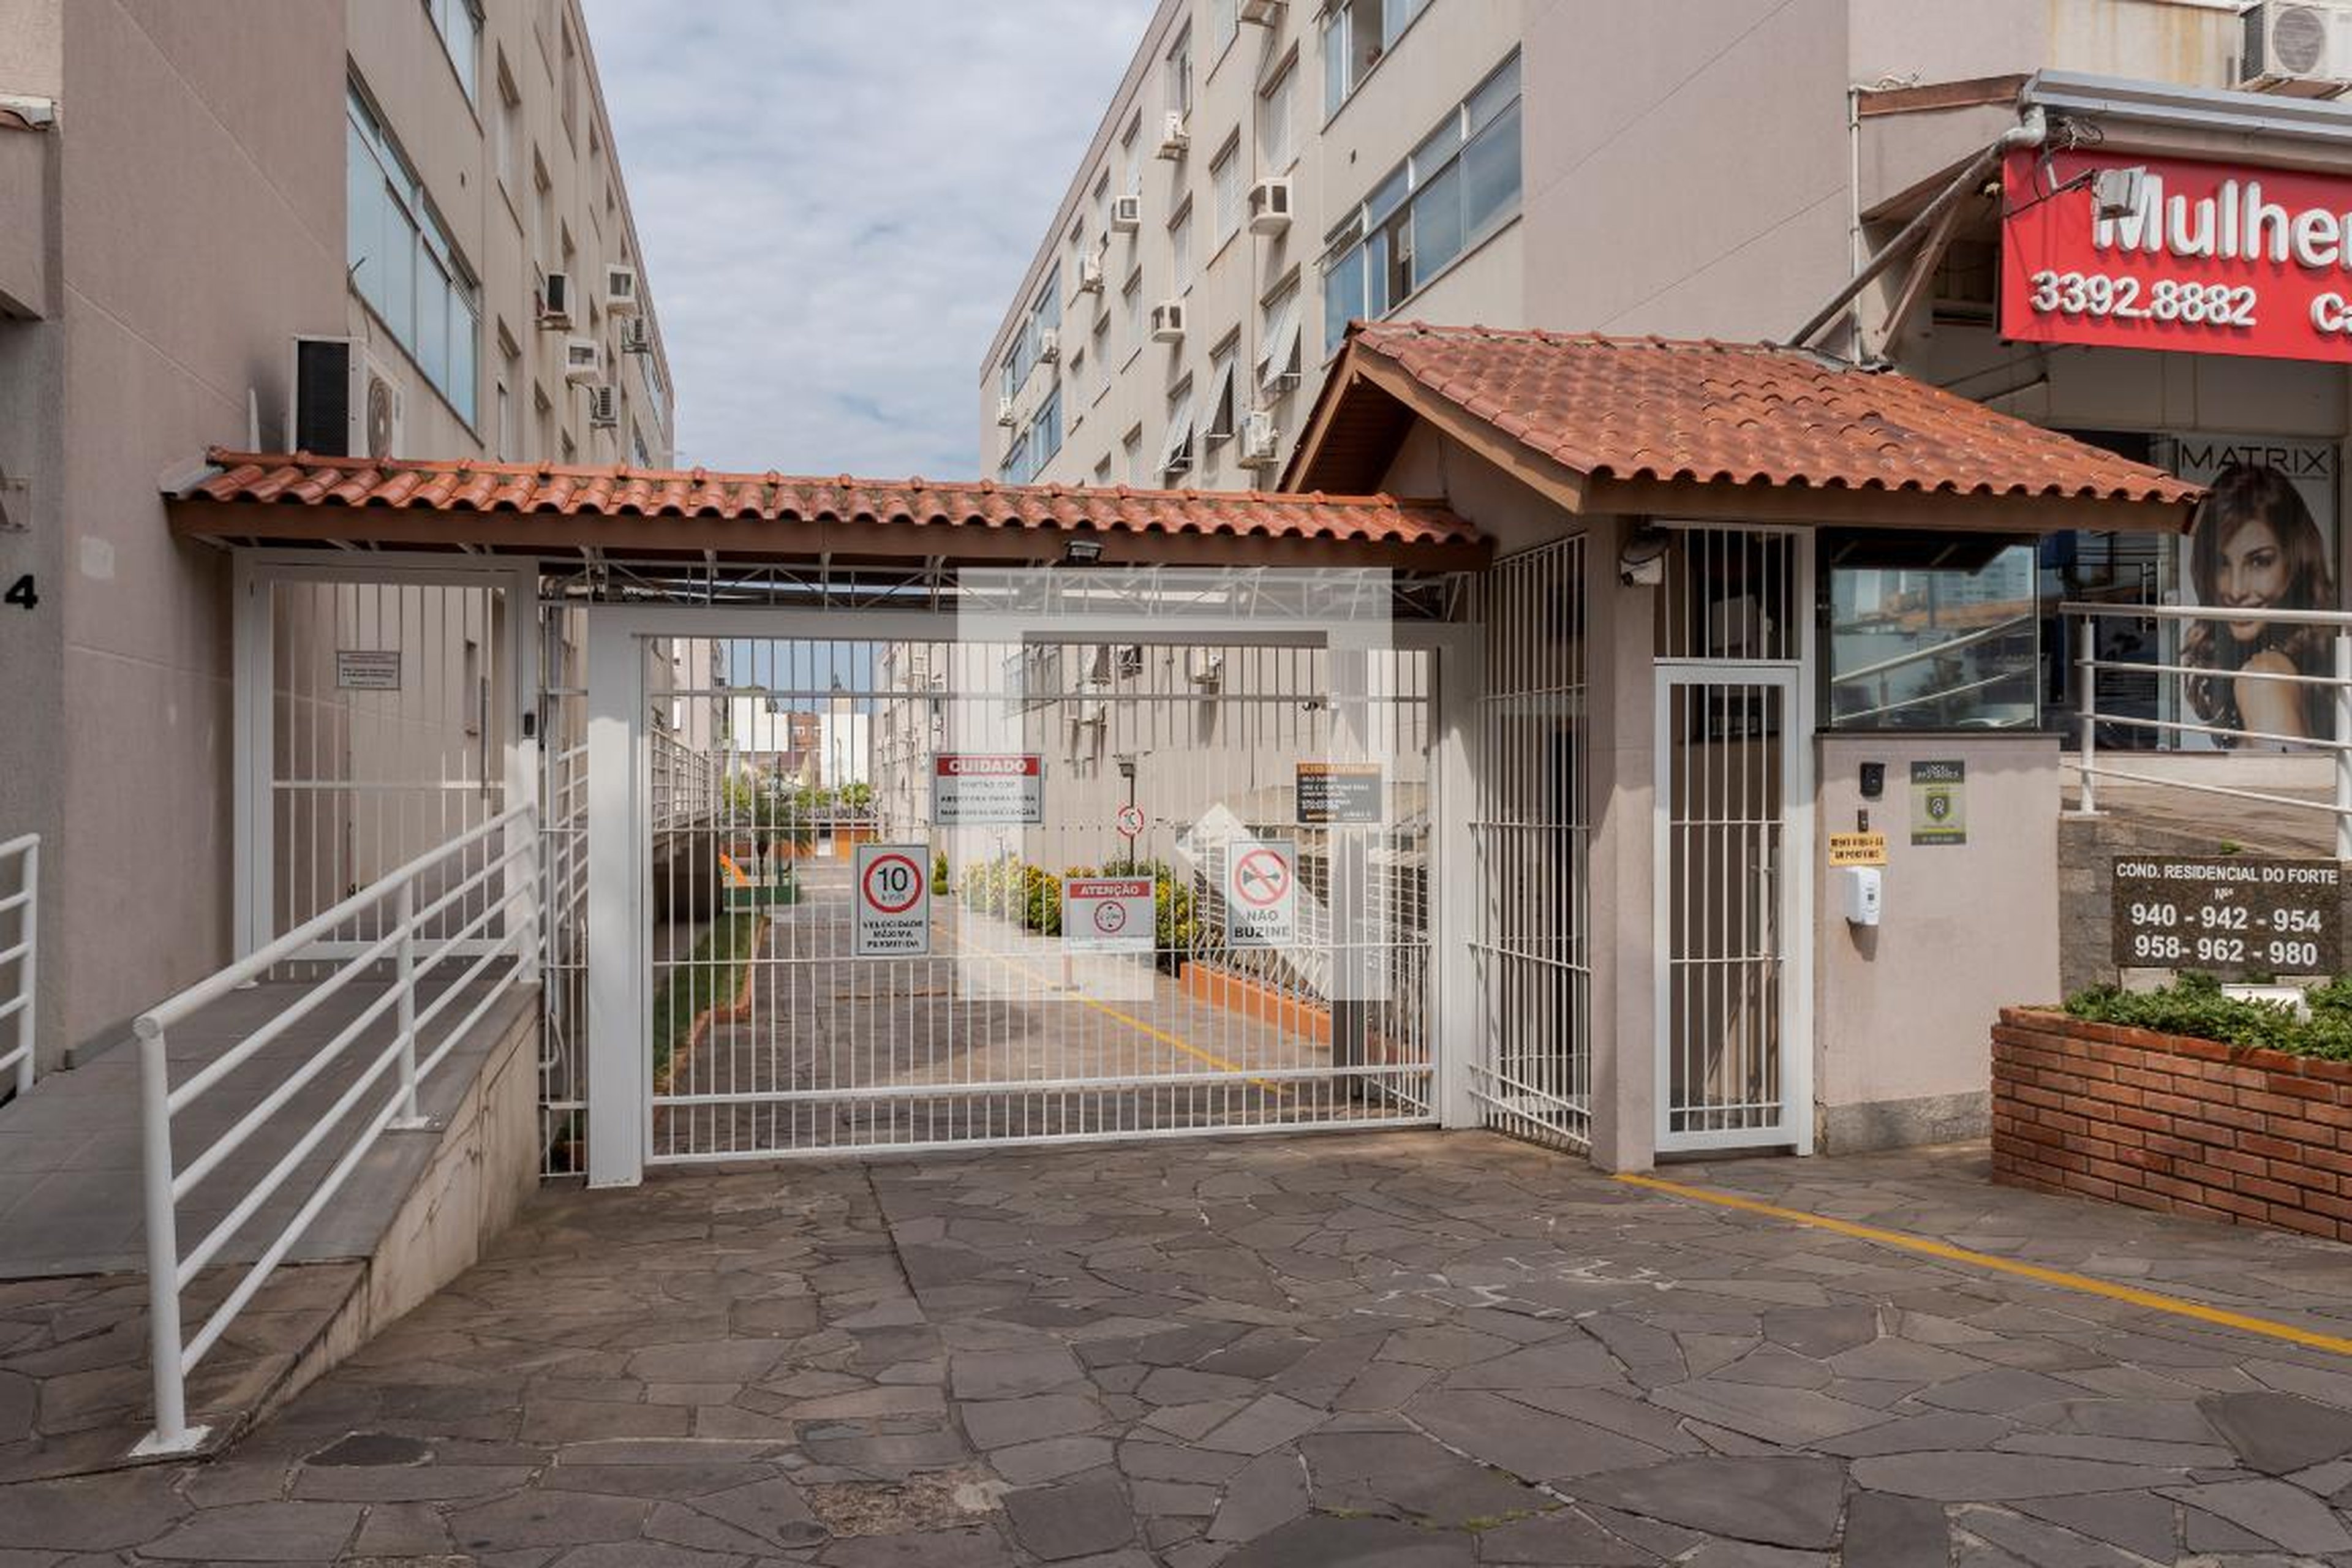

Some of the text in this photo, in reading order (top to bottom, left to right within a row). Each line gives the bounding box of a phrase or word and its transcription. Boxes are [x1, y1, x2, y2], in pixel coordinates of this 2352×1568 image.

[2030, 270, 2258, 327] 3392.8882
[2181, 443, 2329, 475] MATRIX
[949, 759, 1027, 773] CUIDADO
[878, 867, 908, 891] 10
[2117, 862, 2339, 884] COND. RESIDENCIAL DO FORTE
[1080, 884, 1139, 897] ATENÇÃO
[862, 920, 924, 929] VELOCIDADE
[1246, 910, 1279, 921] NÃO
[2131, 903, 2177, 927] 940
[2200, 906, 2248, 930] 942
[2273, 908, 2323, 933] 954
[1234, 925, 1291, 938] BUZINE
[2197, 937, 2244, 962] 962
[2269, 940, 2318, 967] 980
